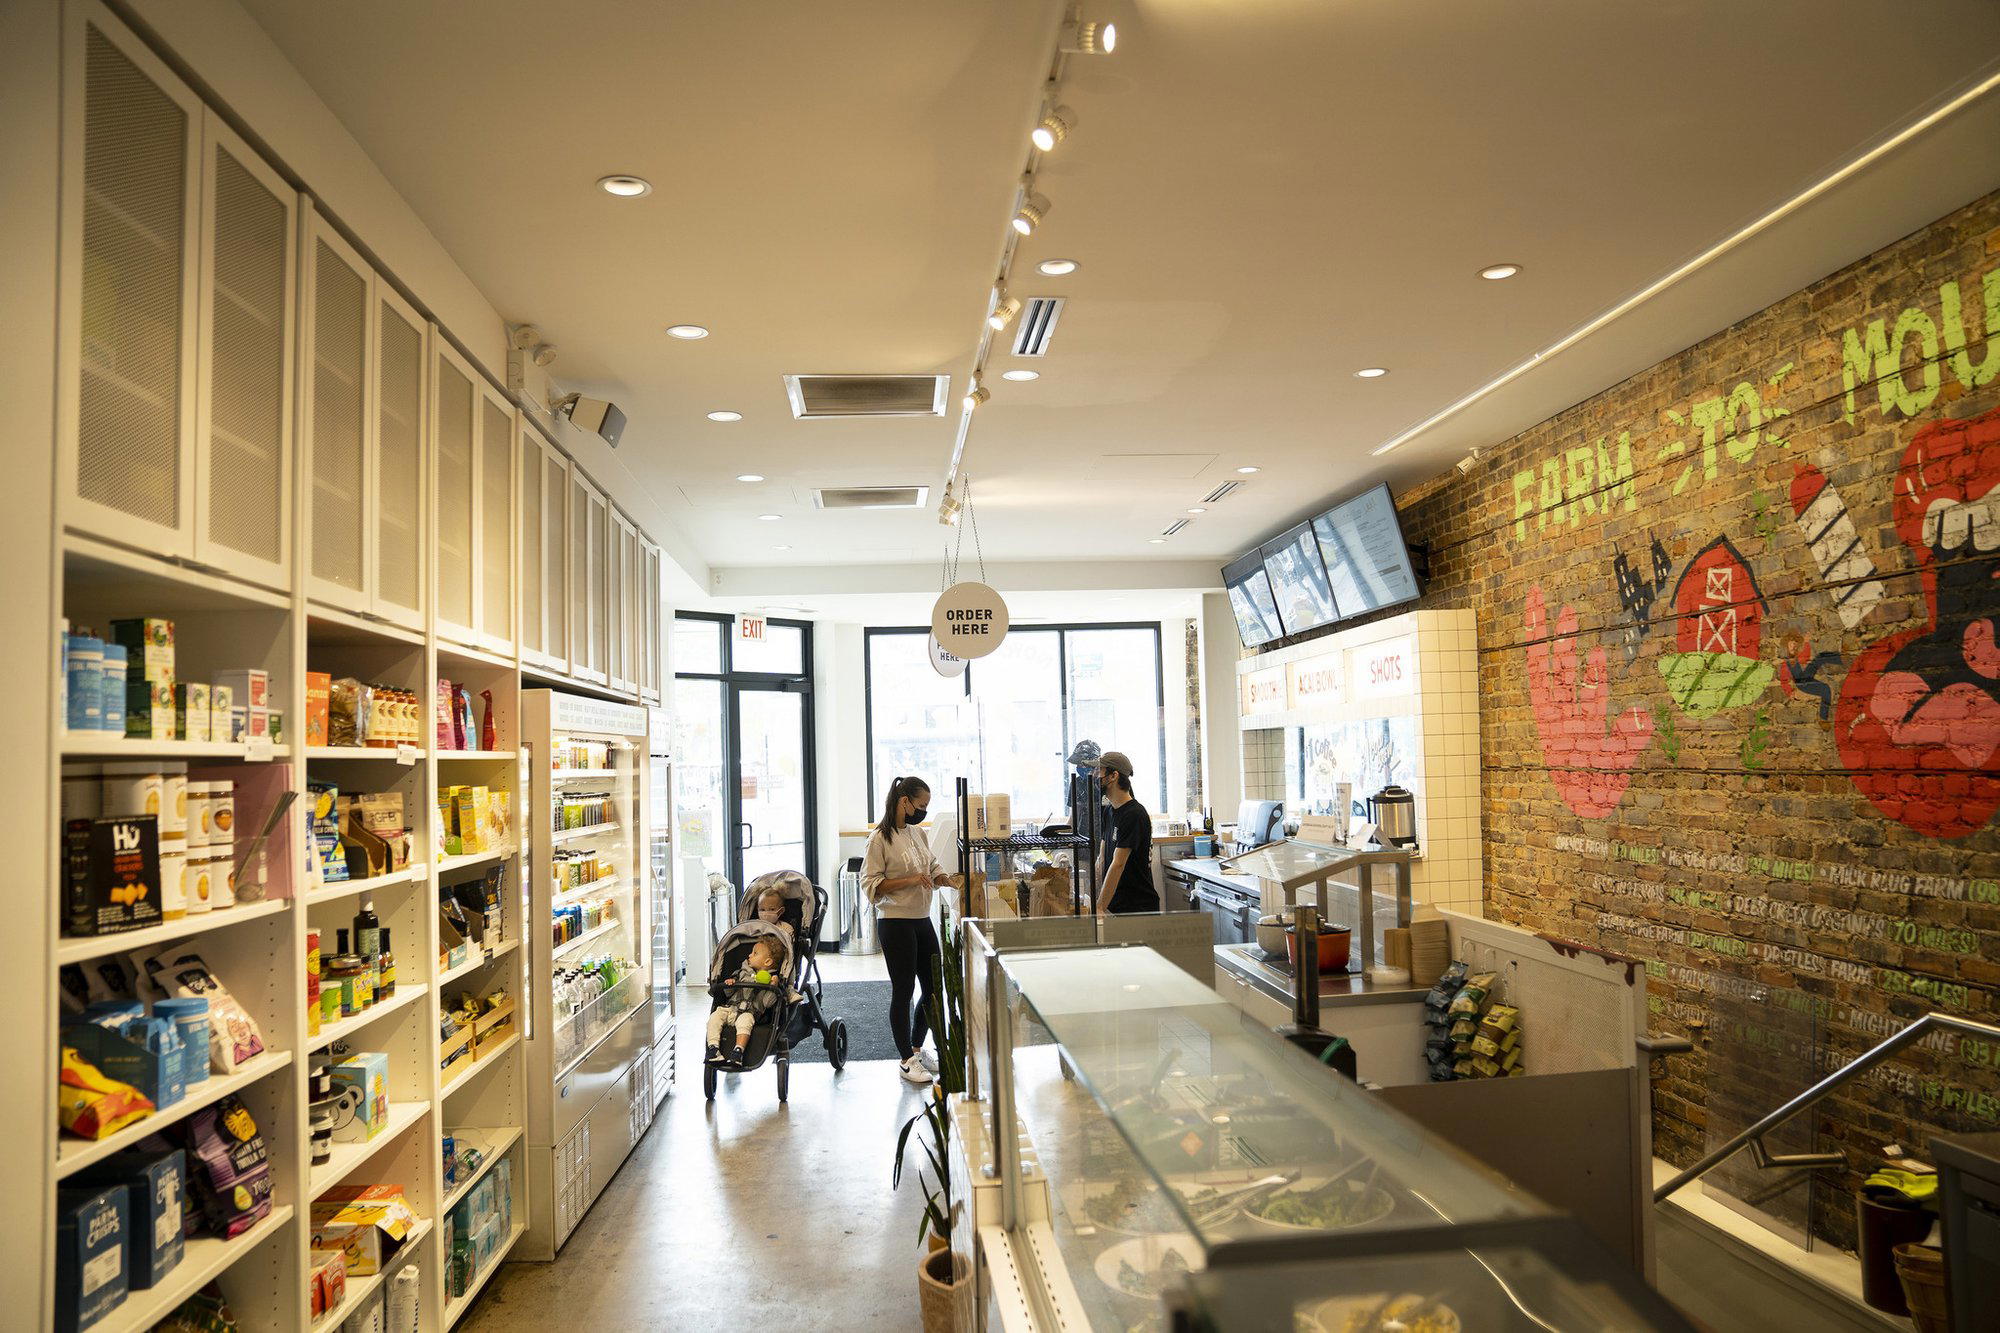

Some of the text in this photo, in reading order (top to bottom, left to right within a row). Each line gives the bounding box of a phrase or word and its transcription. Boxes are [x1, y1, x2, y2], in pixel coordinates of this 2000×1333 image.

[1512, 431, 1637, 542] FARM
[946, 609, 993, 620] ORDER
[742, 619, 763, 639] EXIT
[952, 624, 988, 635] HERE
[1370, 655, 1402, 684] SHOTS
[1585, 838, 1608, 855] FARM
[1772, 860, 1814, 881] MILES)
[1914, 877, 1965, 900] FARM
[1831, 958, 1875, 985] FARM
